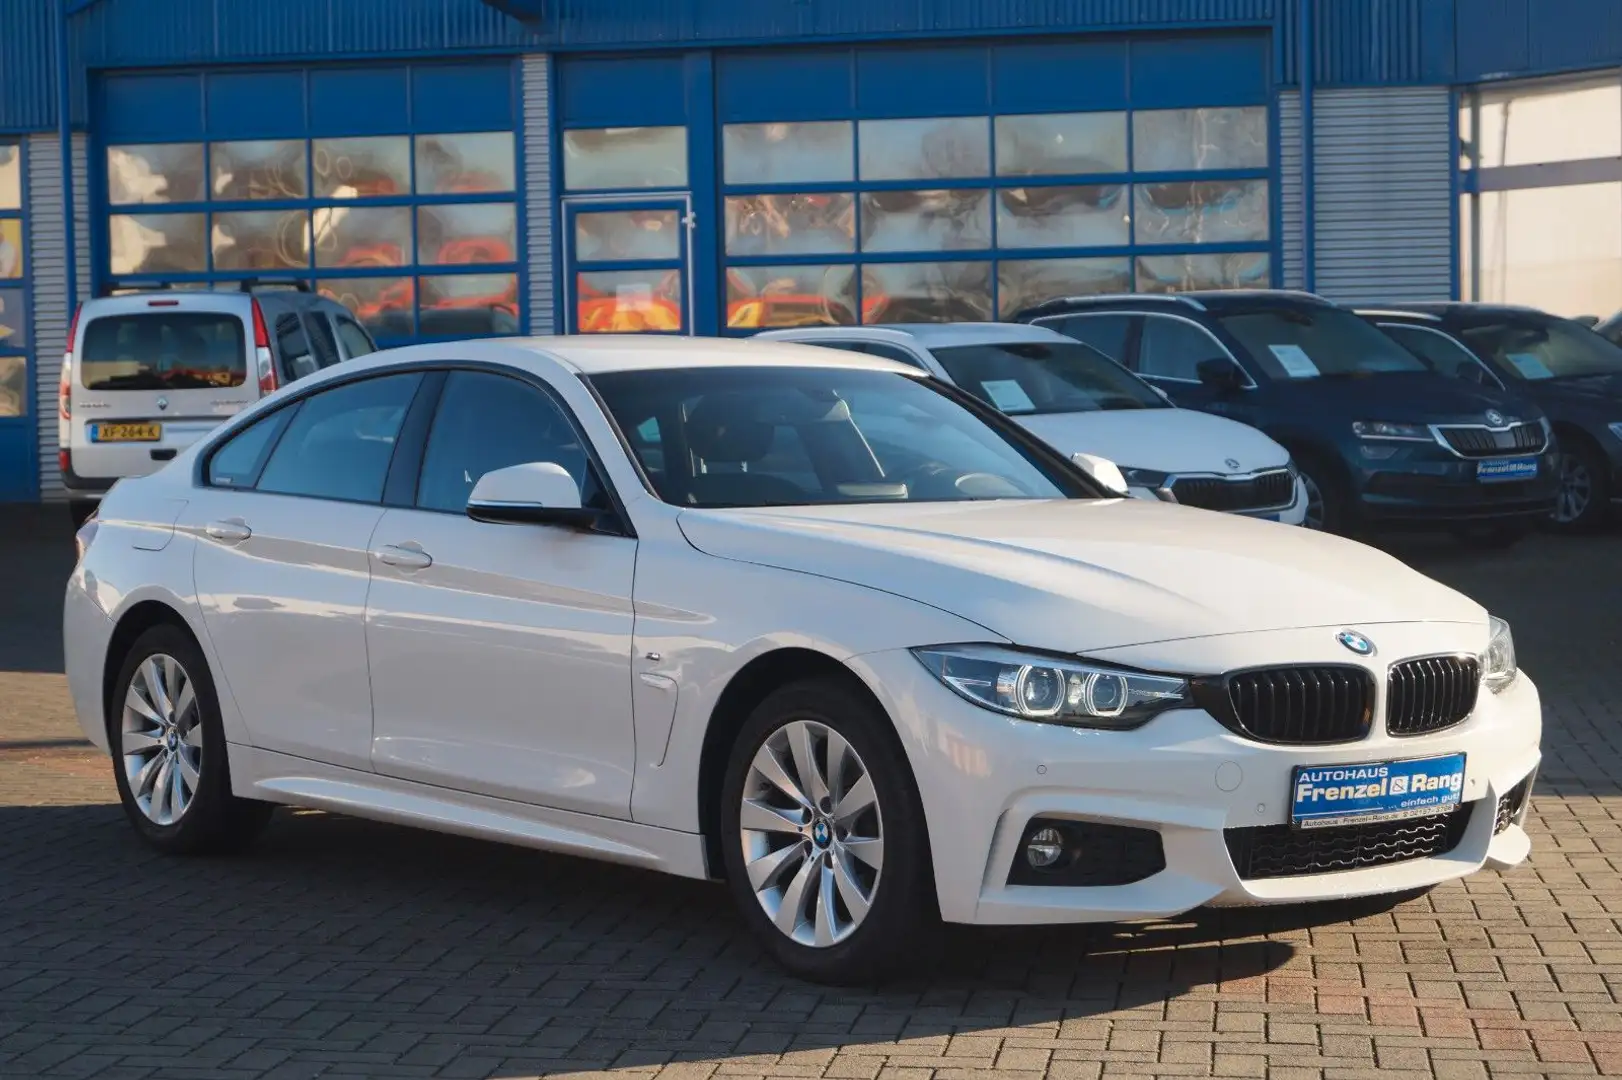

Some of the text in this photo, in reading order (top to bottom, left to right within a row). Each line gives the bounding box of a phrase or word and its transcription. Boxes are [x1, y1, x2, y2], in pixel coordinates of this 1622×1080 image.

[1299, 767, 1389, 782] AUTOHAUS
[1296, 778, 1387, 802] Frenzel
[1411, 772, 1462, 792] Rang
[1400, 796, 1438, 807] einfach
